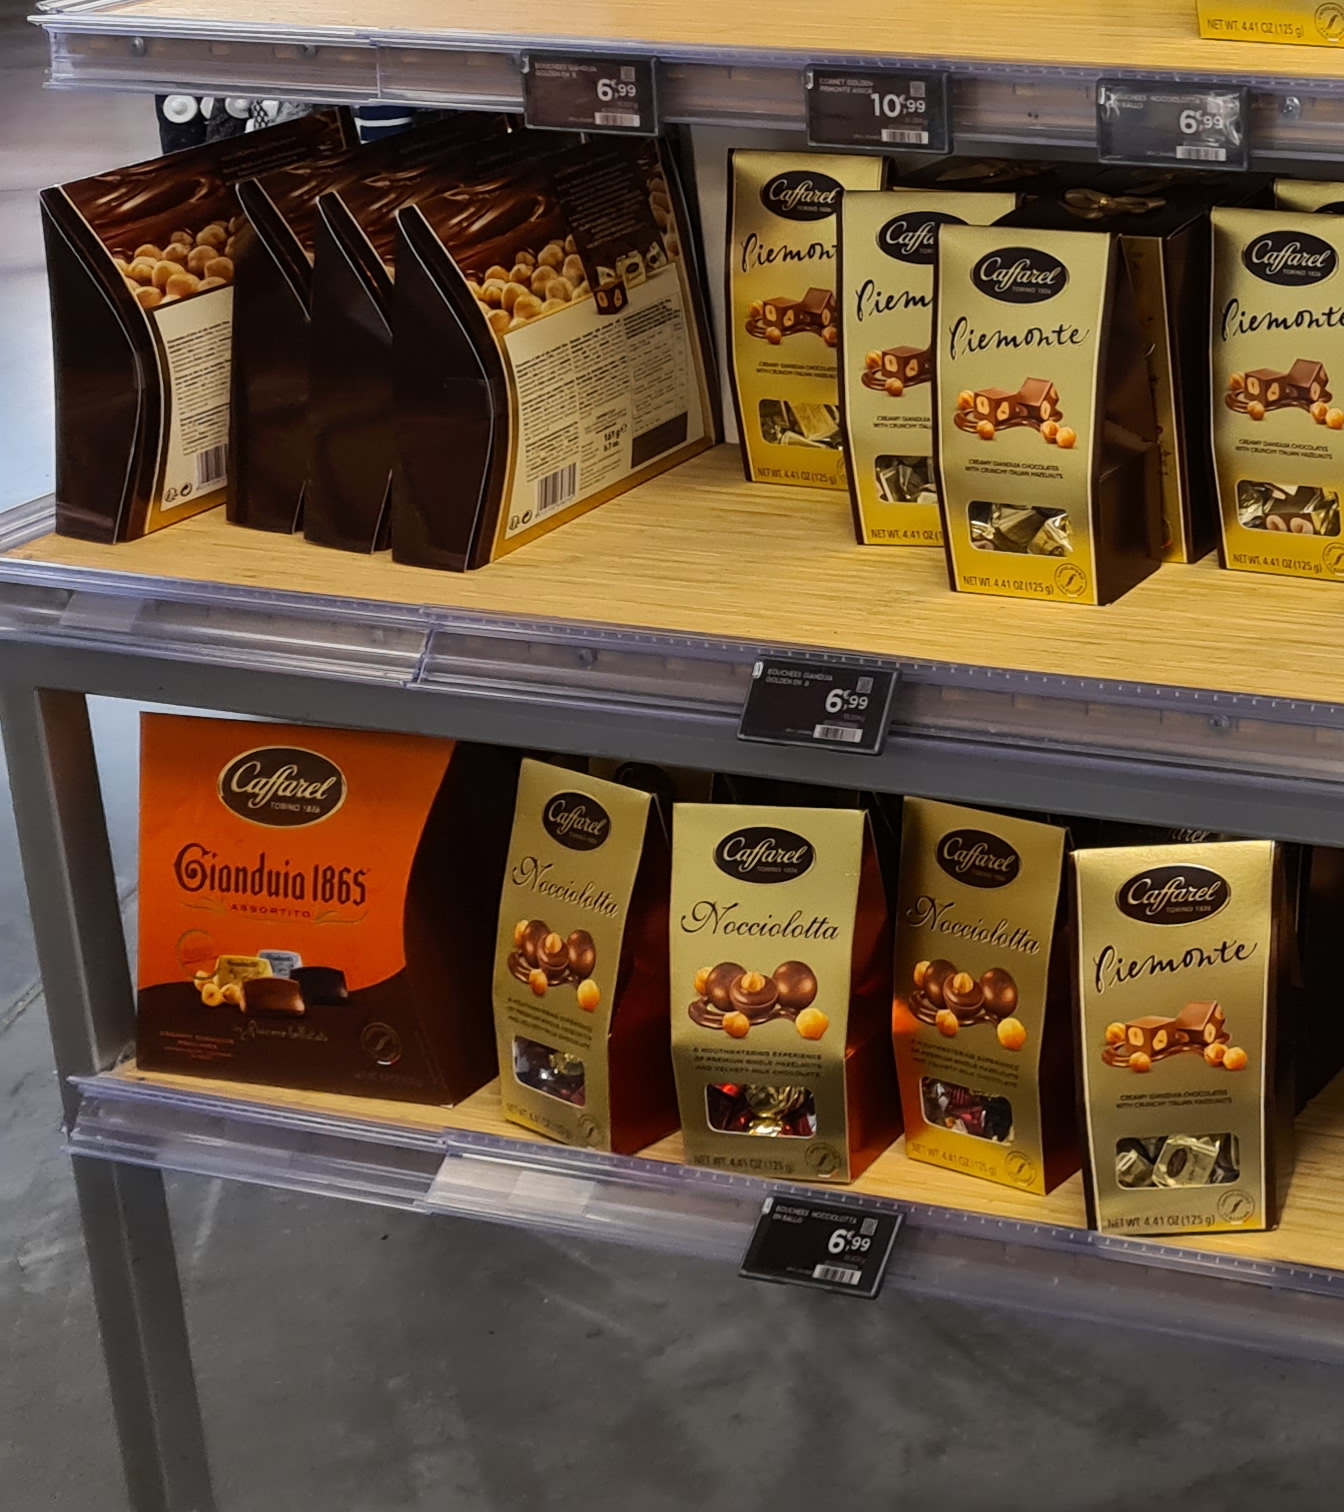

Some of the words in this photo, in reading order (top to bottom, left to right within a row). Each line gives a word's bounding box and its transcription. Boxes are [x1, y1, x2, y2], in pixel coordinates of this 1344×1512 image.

[769, 179, 837, 211] Caffarel
[979, 257, 1062, 292] Caffarel
[1250, 240, 1330, 274] Caffarel
[949, 317, 1090, 361] Piemonte
[231, 761, 337, 808] Caffarel
[548, 800, 605, 836] Caffarel
[723, 837, 803, 872] Caffarel
[942, 837, 1014, 872] Caffarel
[173, 843, 306, 900] Gianduia
[312, 864, 371, 906] 1865
[513, 856, 619, 918] Nocciolotta
[231, 904, 311, 918] ASSORTITO
[1126, 878, 1217, 915] Caffarel
[681, 900, 841, 941] Nocciolotta
[905, 895, 1040, 955] Nocciolotta
[1094, 940, 1257, 994] Piemonte
